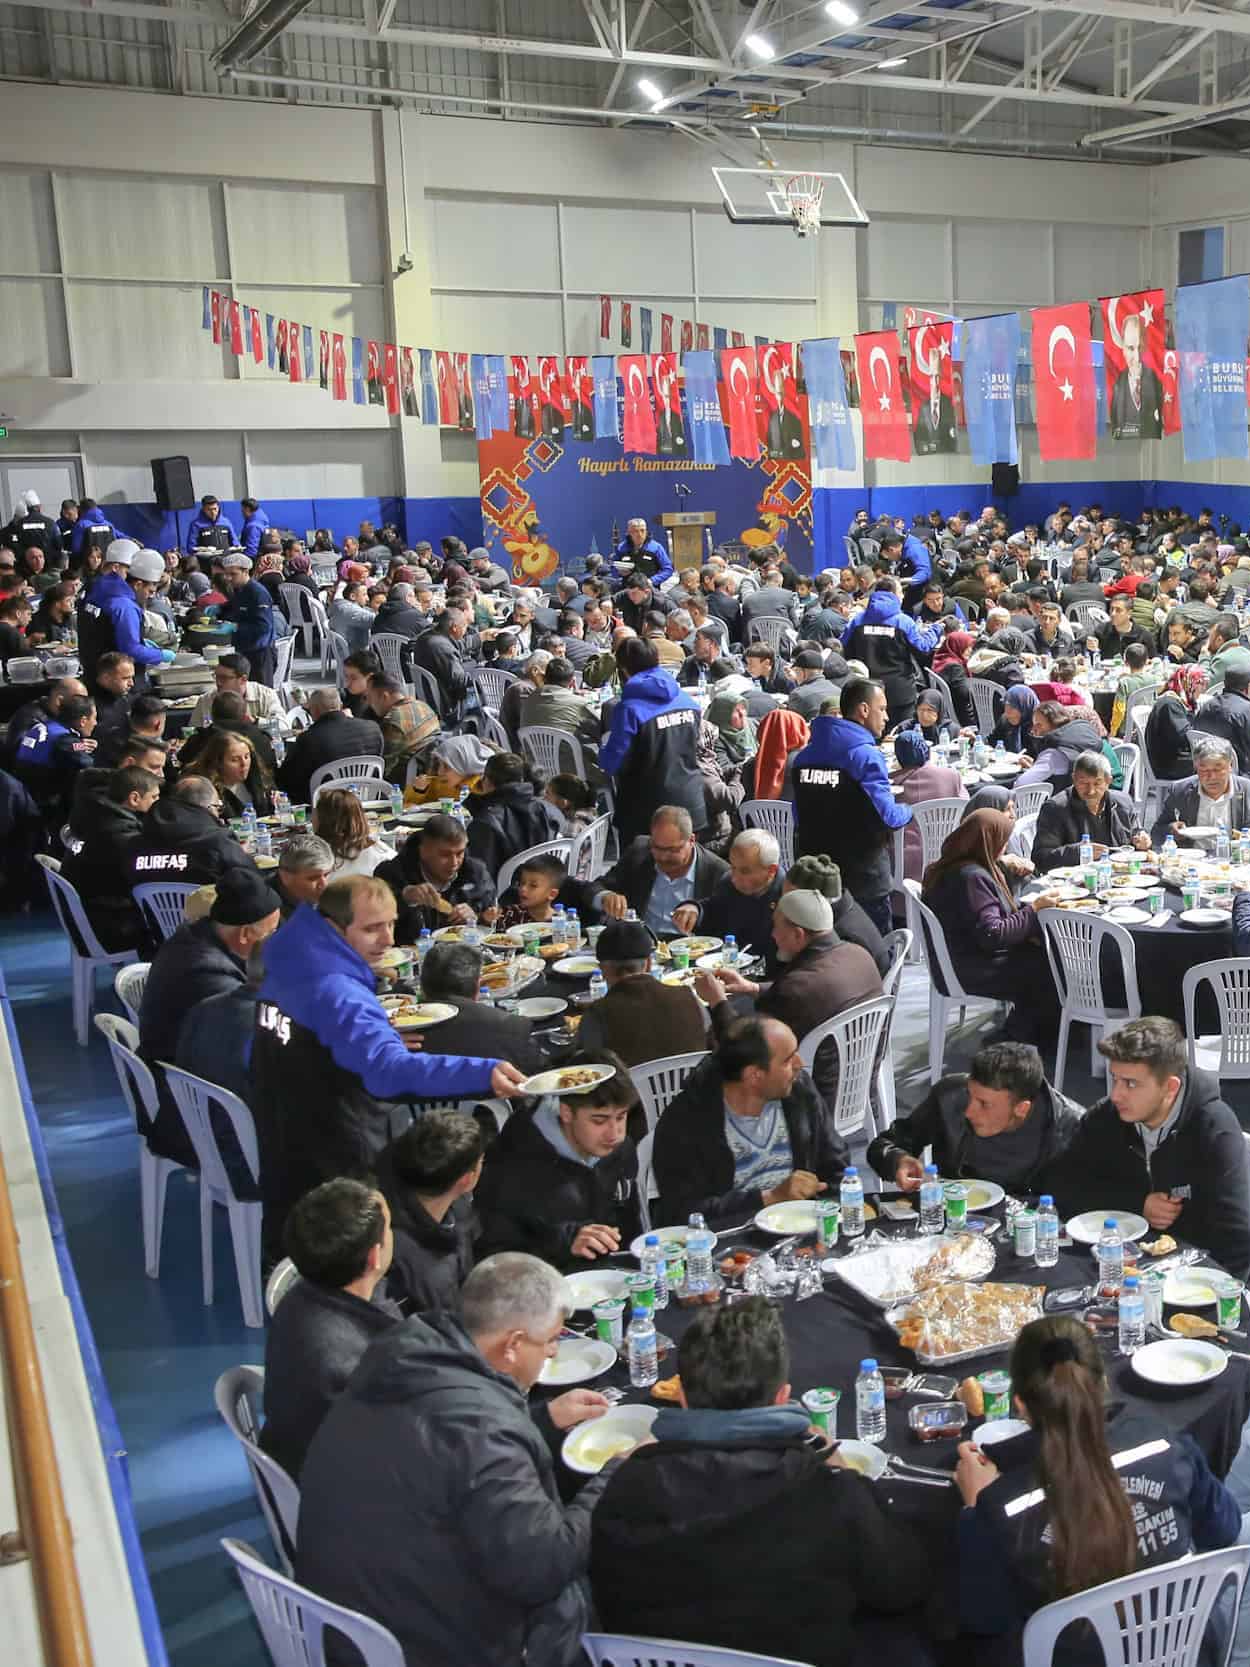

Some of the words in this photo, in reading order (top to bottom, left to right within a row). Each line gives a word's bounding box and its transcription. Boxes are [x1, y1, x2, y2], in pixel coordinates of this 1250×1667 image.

[578, 457, 629, 477] Hayırlı
[135, 854, 188, 871] BURFAŞ
[1160, 1520, 1178, 1545] 55
